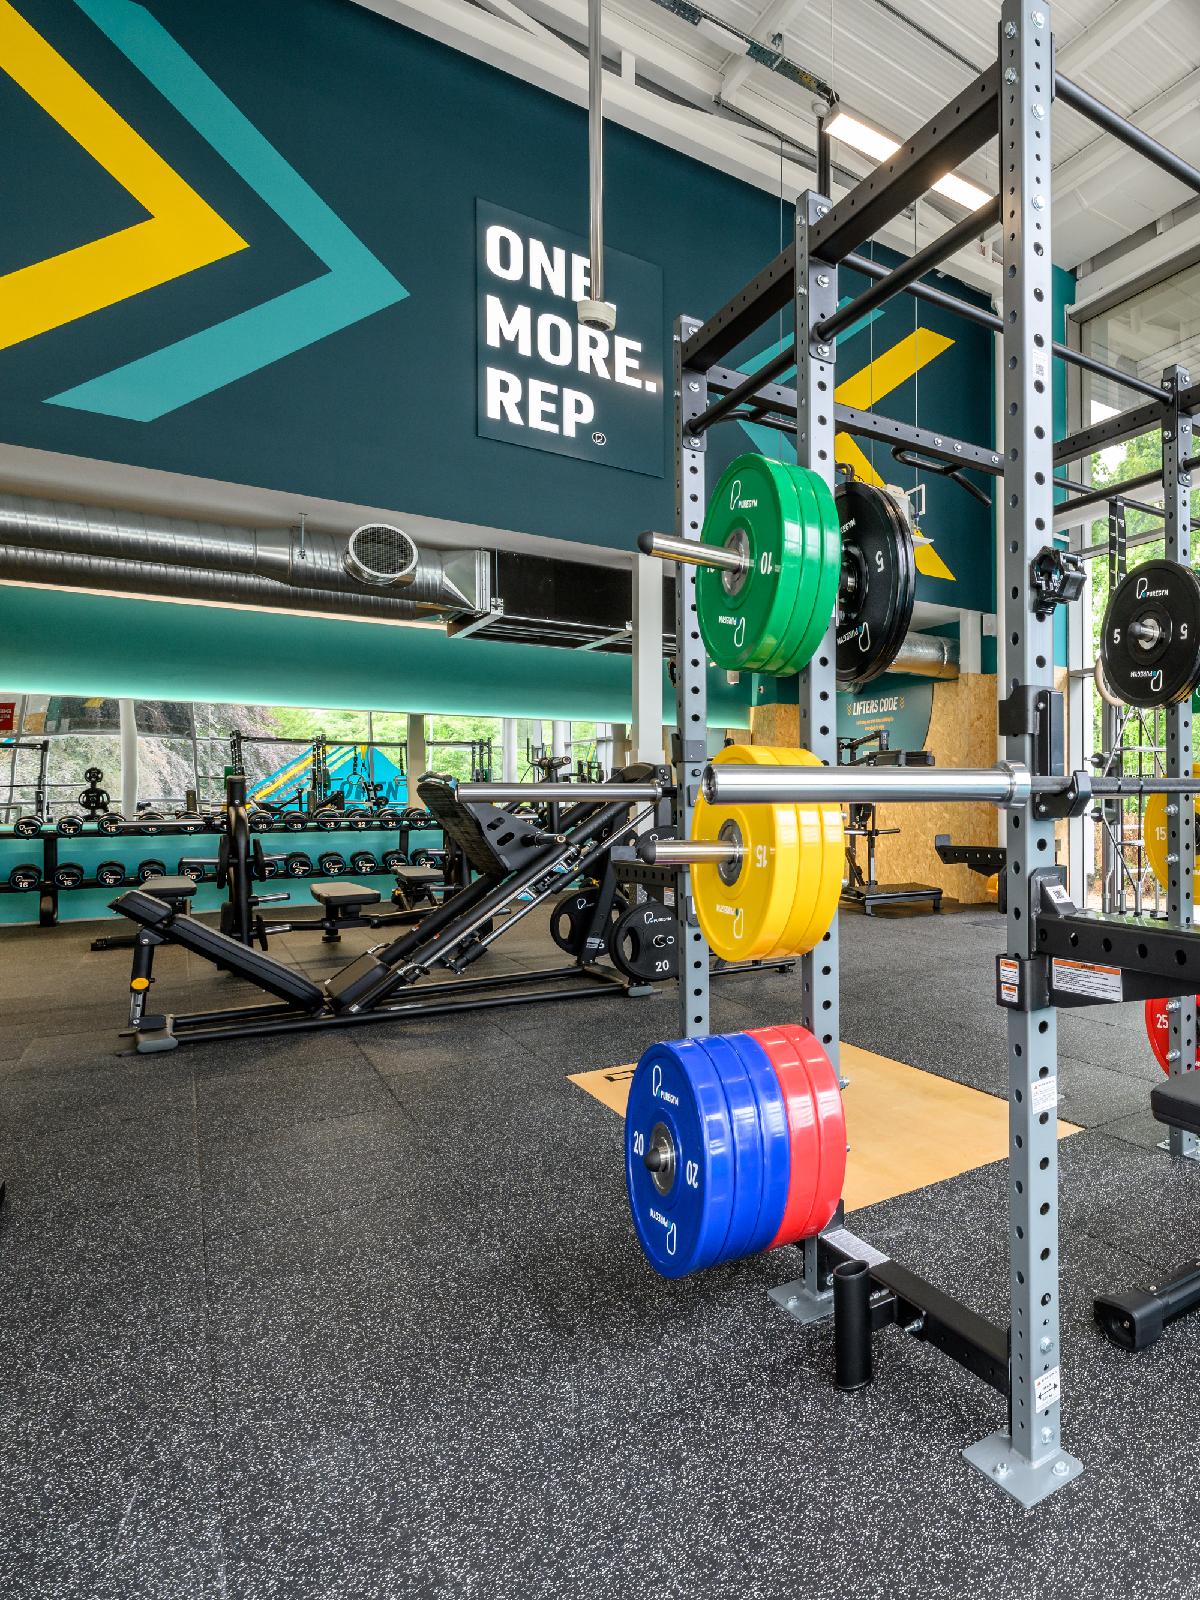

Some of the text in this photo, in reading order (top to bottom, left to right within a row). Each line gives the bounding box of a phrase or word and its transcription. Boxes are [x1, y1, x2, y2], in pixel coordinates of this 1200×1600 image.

[486, 294, 657, 393] MORE.
[486, 366, 595, 437] REP
[760, 551, 773, 575] 10
[875, 550, 885, 573] 5
[1146, 589, 1169, 597] PUREGYM
[1113, 628, 1121, 645] 5
[1180, 623, 1188, 640] 5
[1130, 670, 1153, 678] PUREGYM
[852, 696, 899, 716] LIFTERS CODE
[1155, 827, 1167, 841] 15
[754, 844, 768, 868] 15
[655, 960, 670, 972] 20
[1156, 1013, 1168, 1029] 25
[633, 1130, 645, 1156] 20
[686, 1160, 699, 1189] 20
